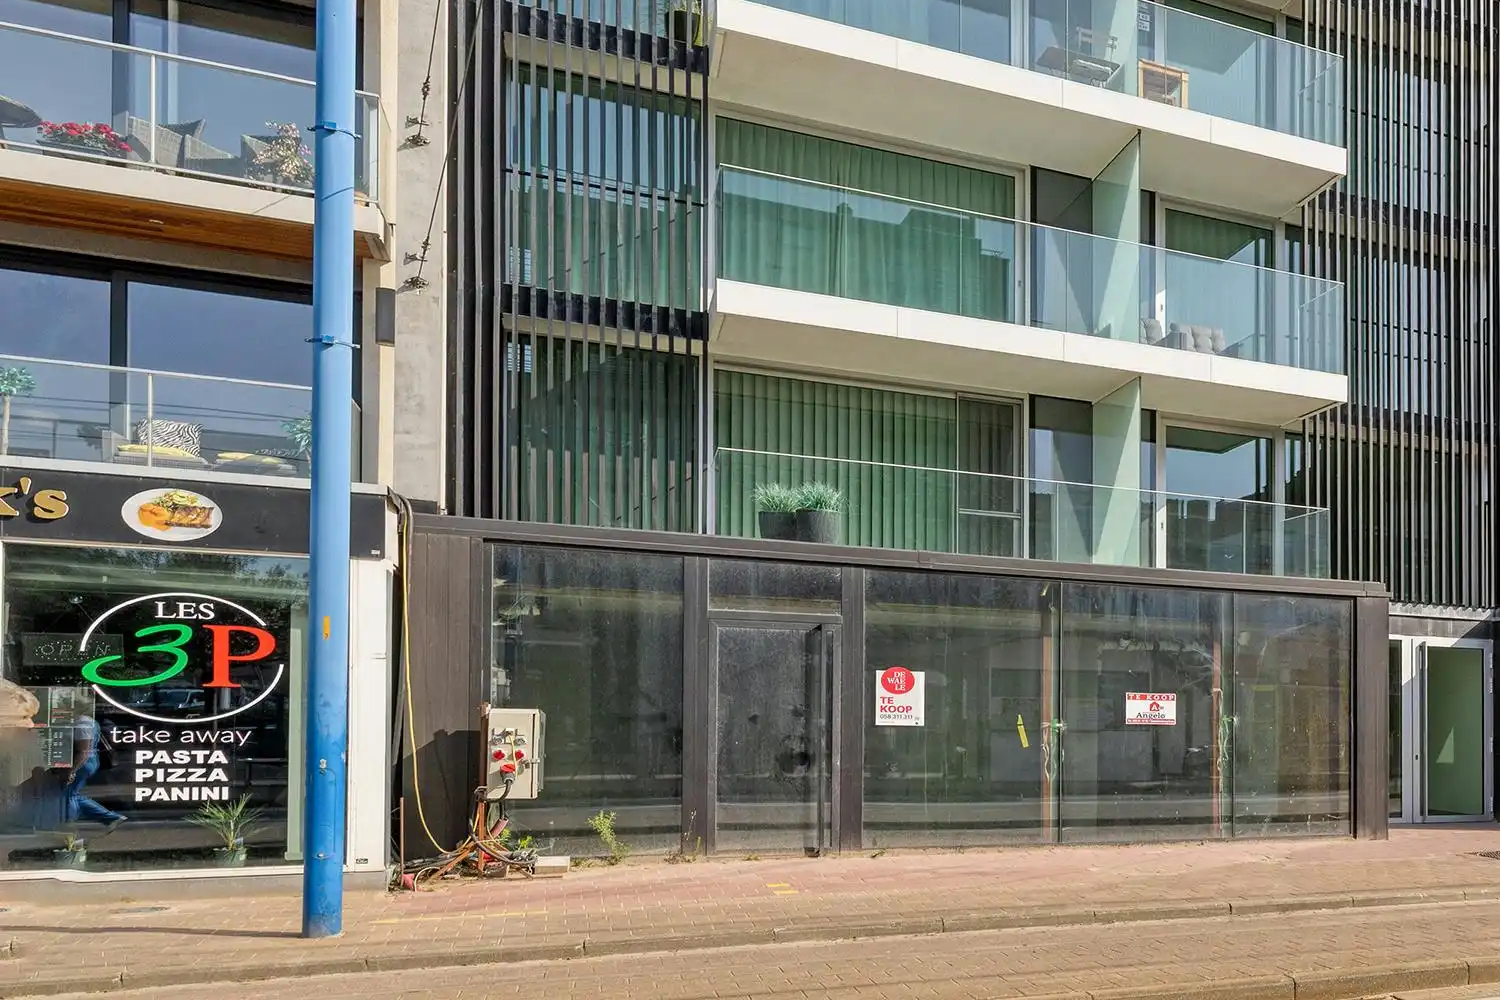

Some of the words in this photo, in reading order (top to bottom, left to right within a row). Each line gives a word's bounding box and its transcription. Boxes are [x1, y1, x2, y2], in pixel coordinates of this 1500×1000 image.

[155, 601, 215, 620] LES
[880, 696, 894, 704] TE
[880, 705, 912, 713] KOOP
[110, 726, 171, 744] take
[180, 730, 252, 746] away
[135, 750, 228, 765] PASTA
[135, 768, 228, 783] PIZZA
[135, 786, 229, 802] PANINI
